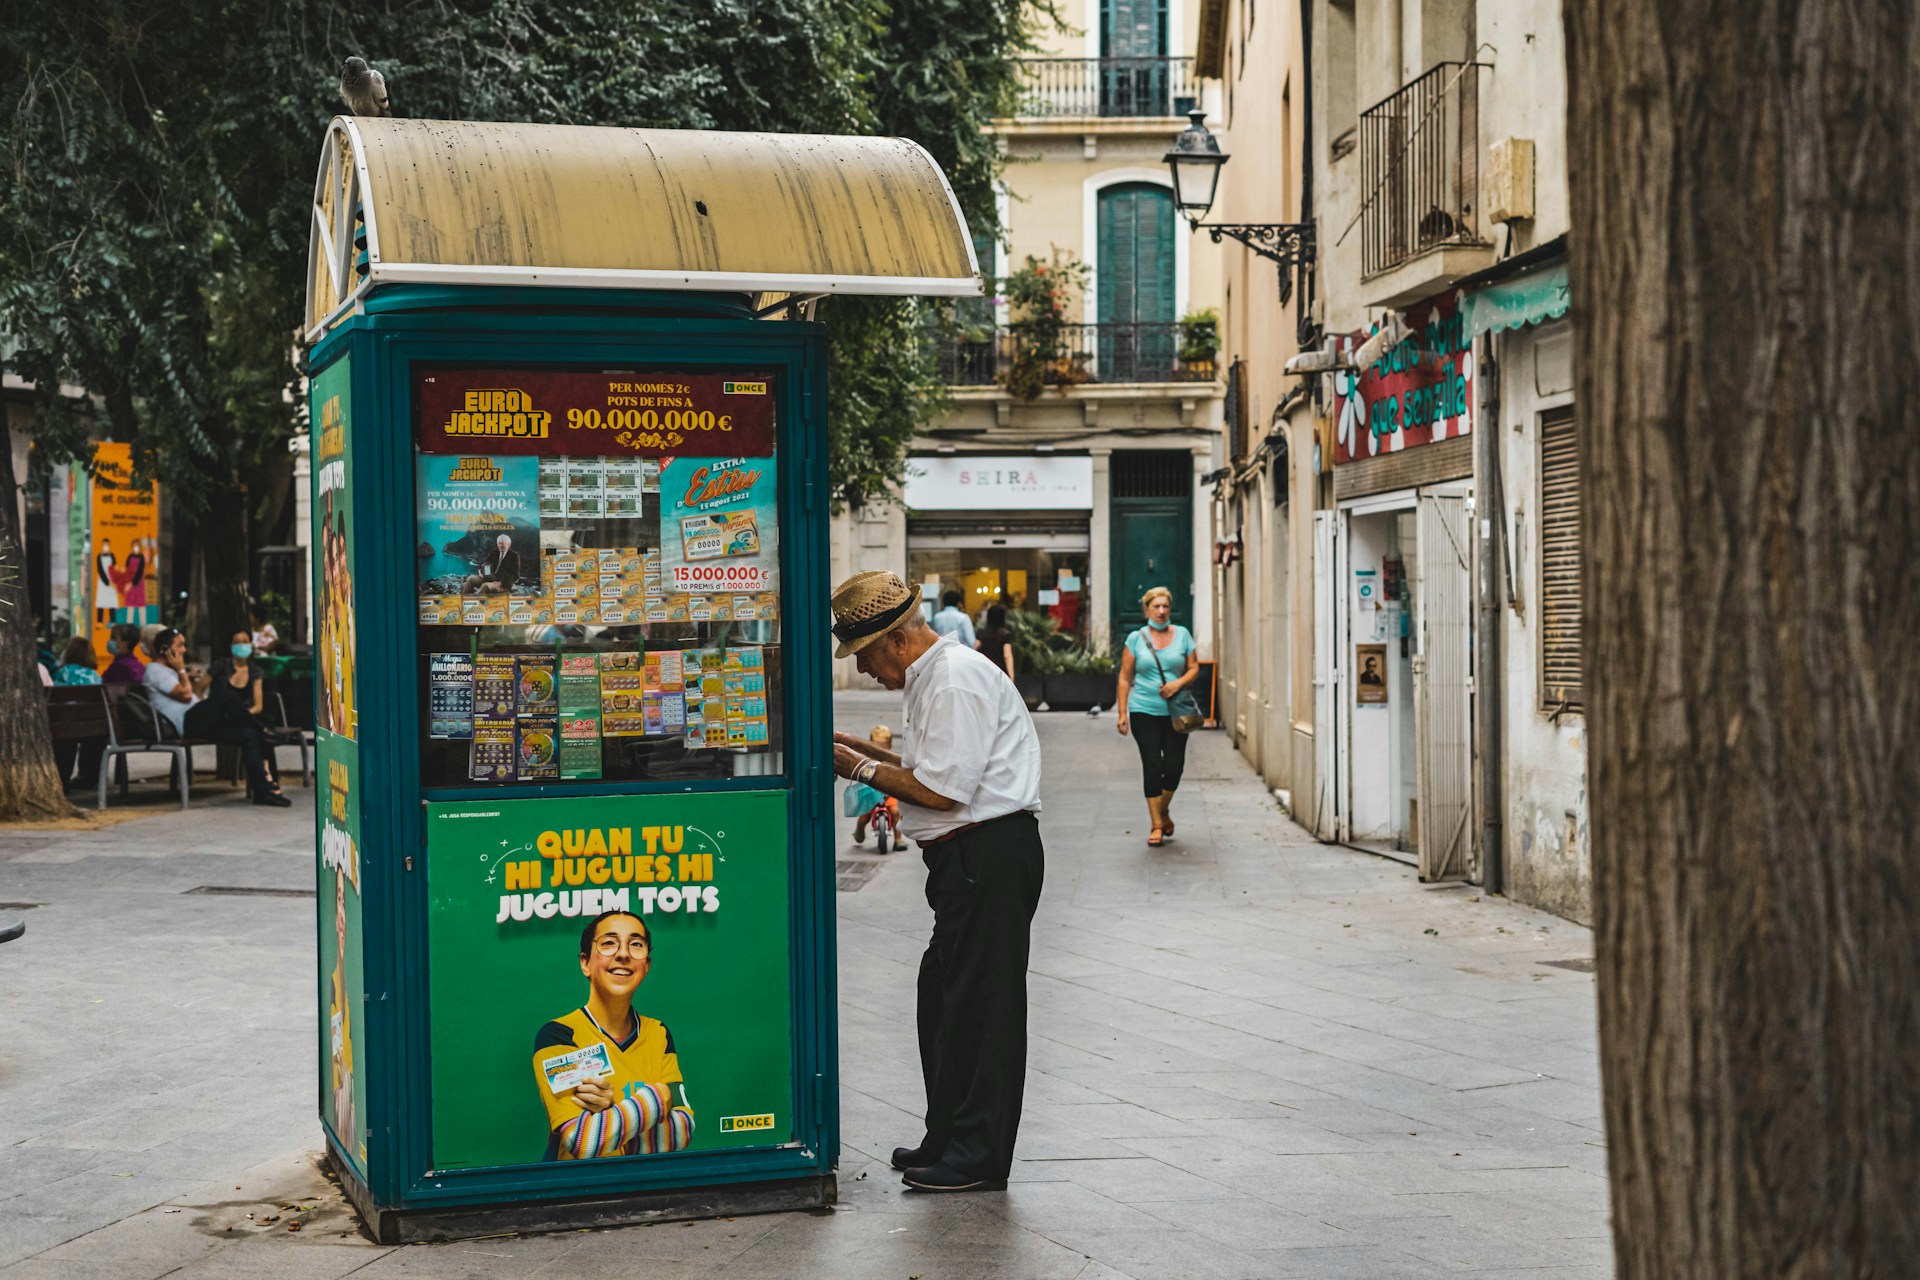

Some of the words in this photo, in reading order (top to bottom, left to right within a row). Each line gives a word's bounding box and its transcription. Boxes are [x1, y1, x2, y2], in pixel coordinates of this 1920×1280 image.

[1424, 305, 1471, 364] mort
[609, 383, 632, 393] PER
[634, 381, 674, 394] NOMÉS
[736, 385, 764, 393] ONCE
[464, 390, 522, 412] EURO
[607, 396, 637, 406] POTS
[640, 397, 655, 407] DE
[657, 397, 682, 407] FINS
[684, 398, 693, 407] A
[1371, 395, 1398, 451] que
[1403, 358, 1466, 431] senzilla
[444, 412, 544, 436] JACKPOT
[459, 458, 486, 469] EURO
[712, 457, 746, 472] EXTRA
[449, 469, 501, 481] JACKPOT
[684, 467, 762, 507] Estiu
[709, 497, 730, 508] agost
[732, 492, 750, 502] 2021
[697, 539, 722, 549] 00000
[674, 567, 759, 581] 15.000.000
[762, 570, 769, 580] €
[443, 654, 463, 664] Mega
[431, 662, 472, 672] MILLONARIO
[536, 827, 632, 859] QUAN
[642, 825, 684, 854] TU
[505, 860, 542, 890] HI
[550, 855, 674, 887] JUGUES,
[678, 853, 713, 882] HI
[496, 887, 629, 923] JUGUEM
[638, 885, 721, 914] TOTS
[736, 1117, 770, 1128] ONCE
